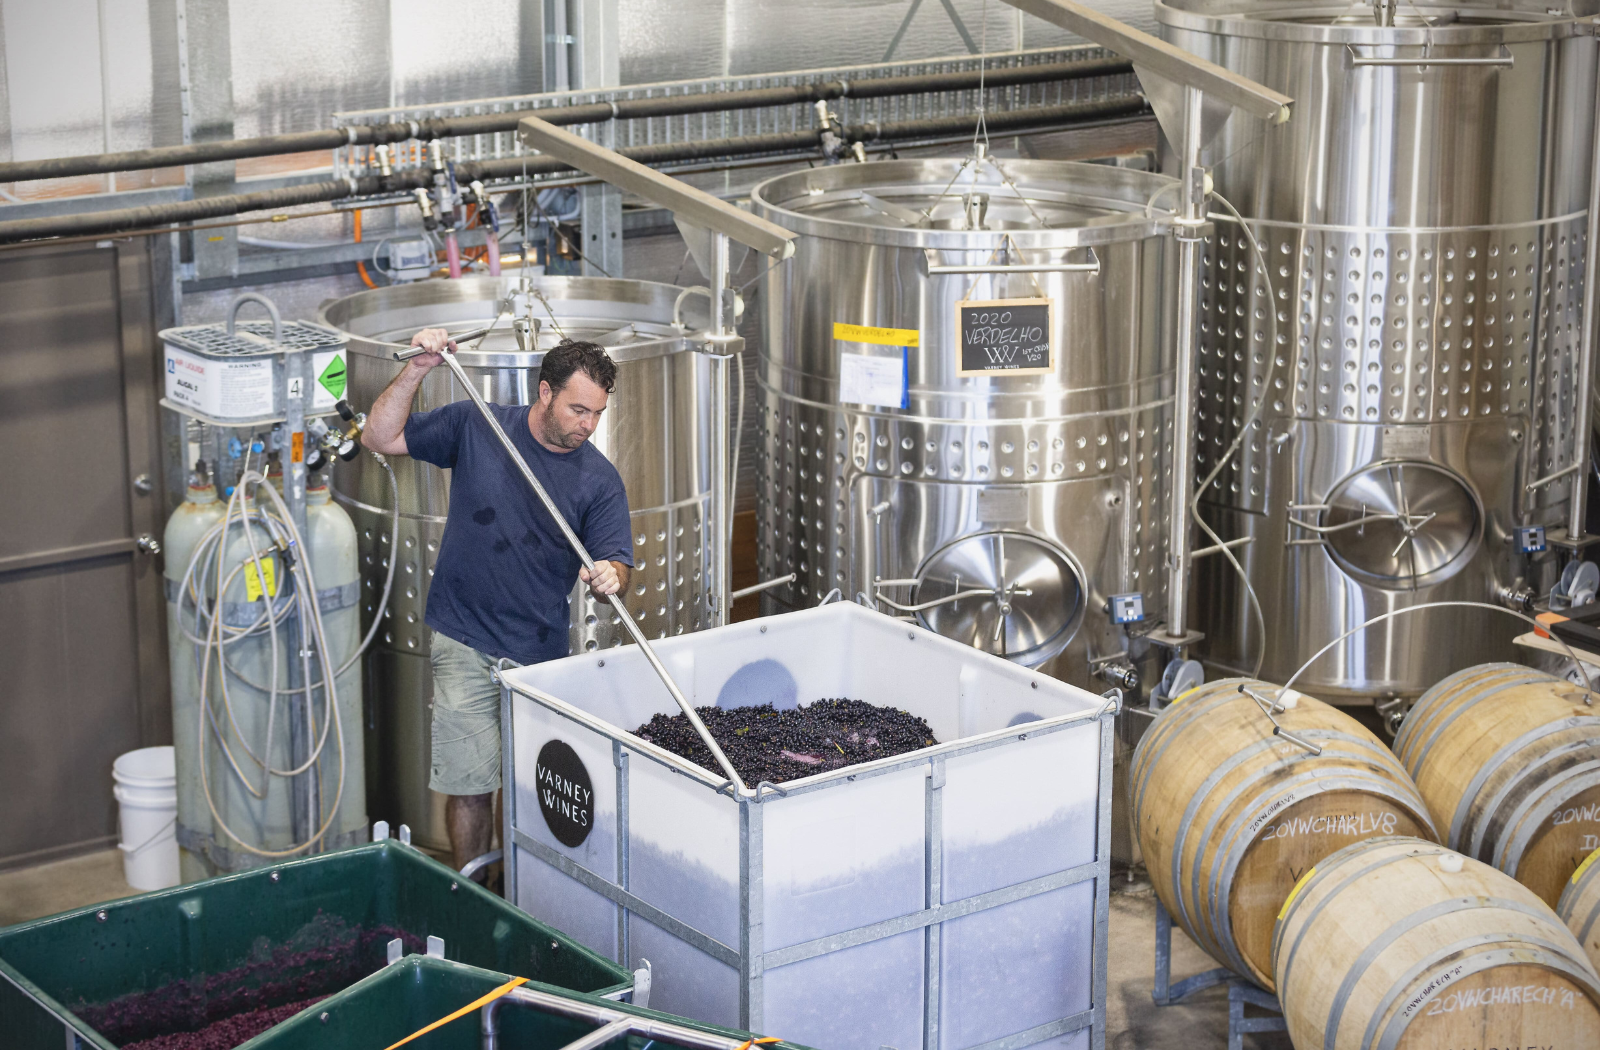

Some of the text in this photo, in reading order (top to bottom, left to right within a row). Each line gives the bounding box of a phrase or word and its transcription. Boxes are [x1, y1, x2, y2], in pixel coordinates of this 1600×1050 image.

[971, 311, 1012, 325] 2020
[965, 326, 1043, 345] VERDELHO
[227, 362, 263, 370] WARNING
[290, 379, 299, 397] 4
[537, 763, 591, 806] VARNEY
